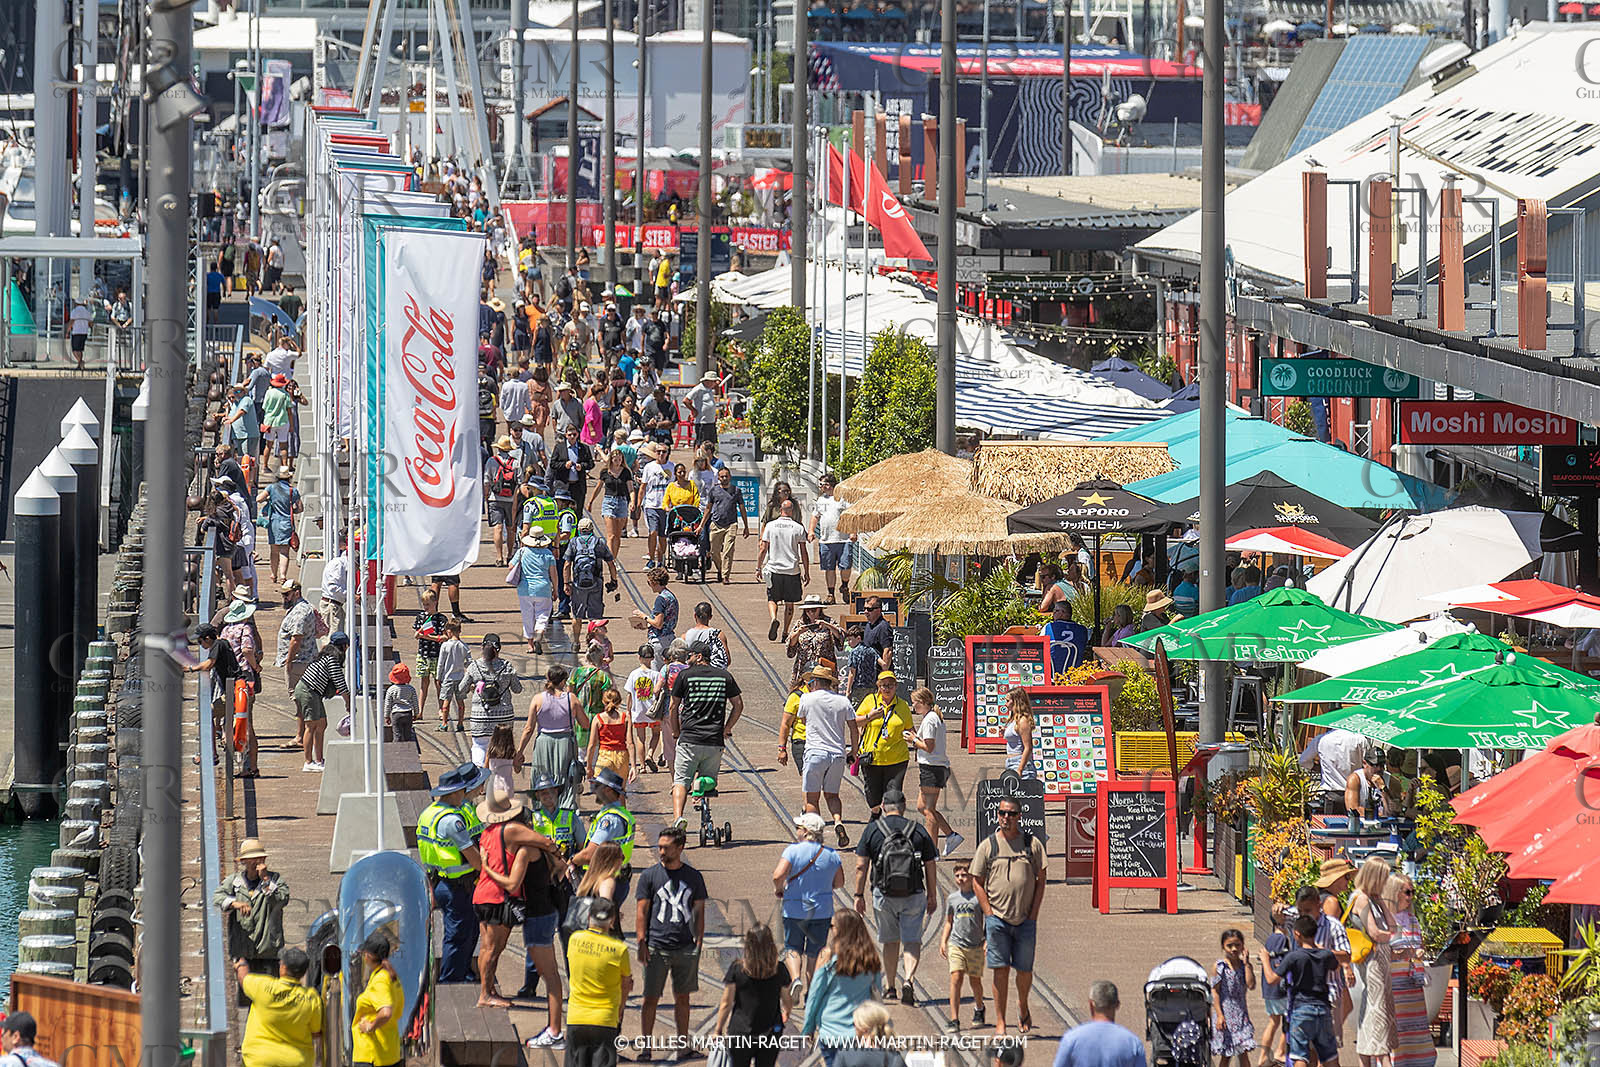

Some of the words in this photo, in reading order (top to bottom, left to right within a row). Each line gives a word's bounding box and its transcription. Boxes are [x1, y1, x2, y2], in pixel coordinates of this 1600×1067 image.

[1002, 280, 1070, 291] conservatory
[1307, 367, 1373, 378] GOODLUCK
[1307, 379, 1372, 394] COCONUT
[402, 291, 457, 508] Coca-Cola
[1411, 411, 1485, 433] Moshi
[1493, 412, 1567, 435] Moshi
[737, 480, 753, 488] BEST
[1056, 508, 1130, 517] SAPPORO
[1059, 520, 1123, 530] サッポロビール
